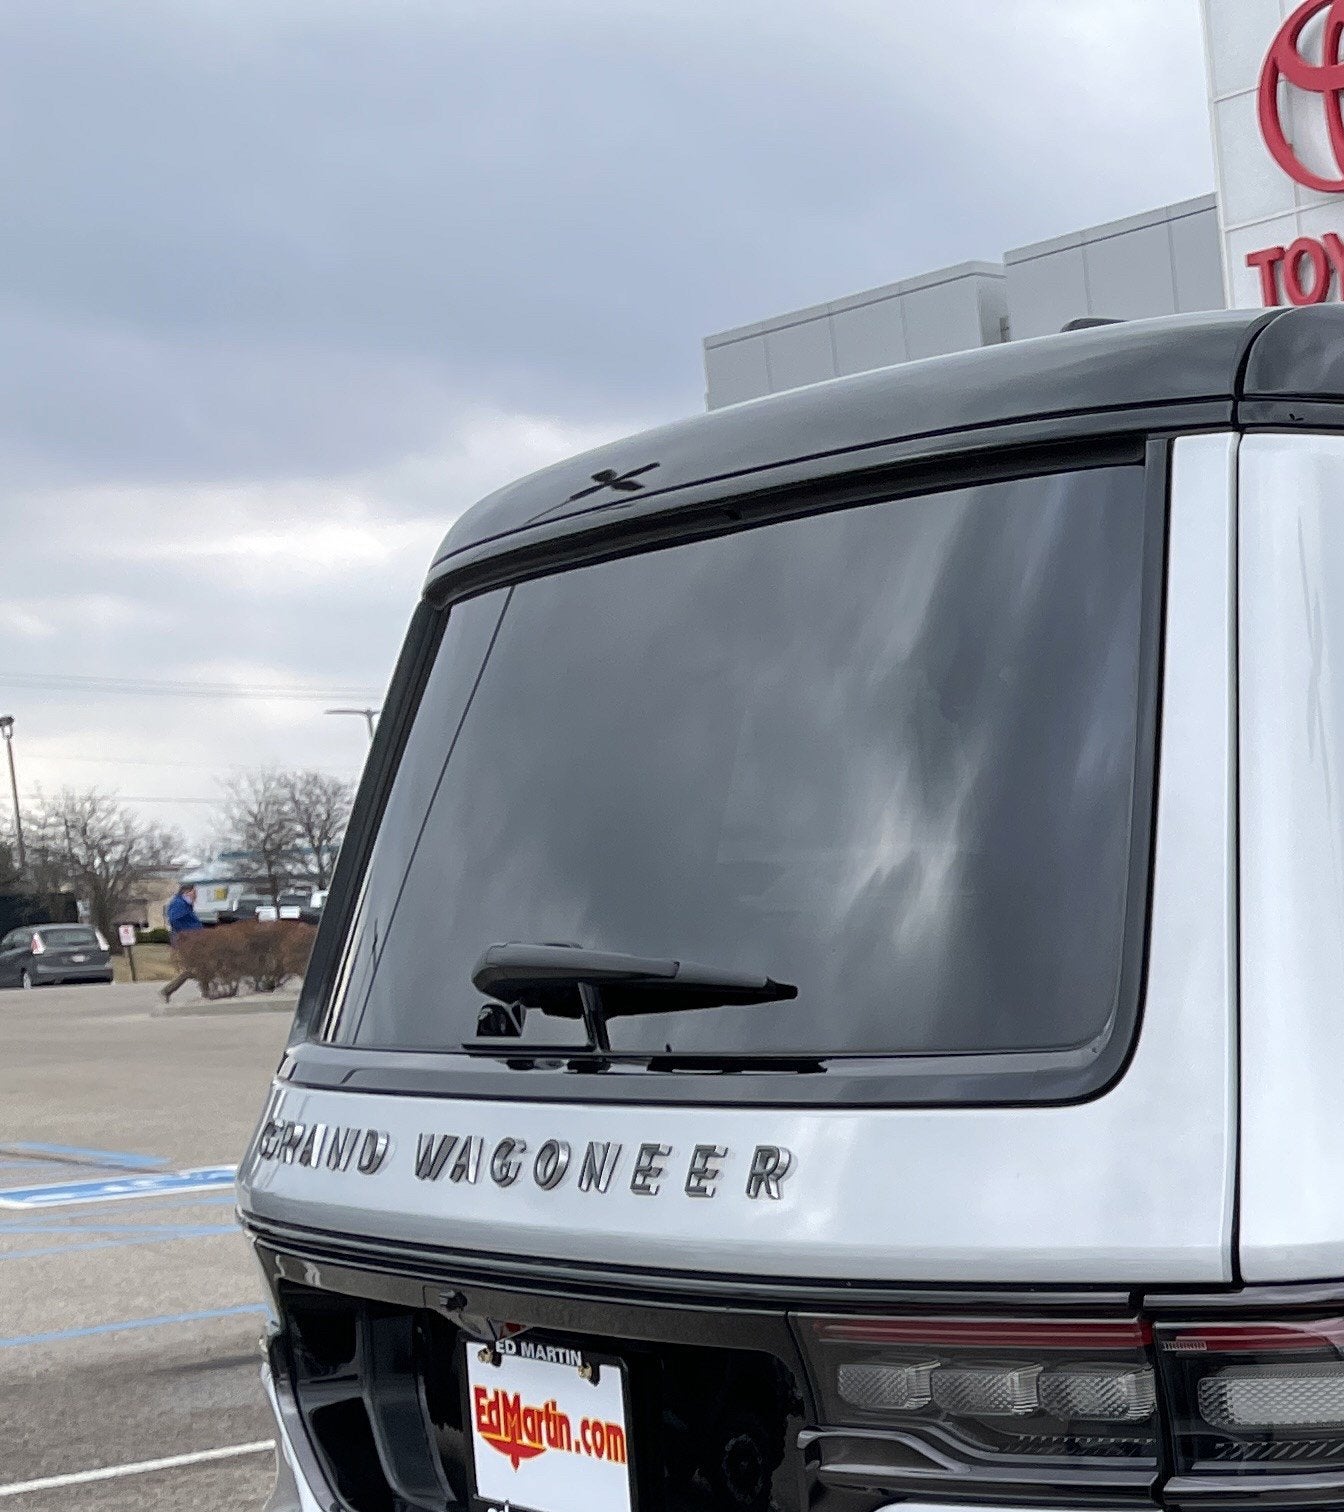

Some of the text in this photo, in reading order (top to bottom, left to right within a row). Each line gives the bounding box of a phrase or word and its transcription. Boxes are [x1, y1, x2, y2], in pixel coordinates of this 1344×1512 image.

[258, 1118, 799, 1201] GRAND WAGONEER
[495, 1340, 583, 1367] ED MARTIN
